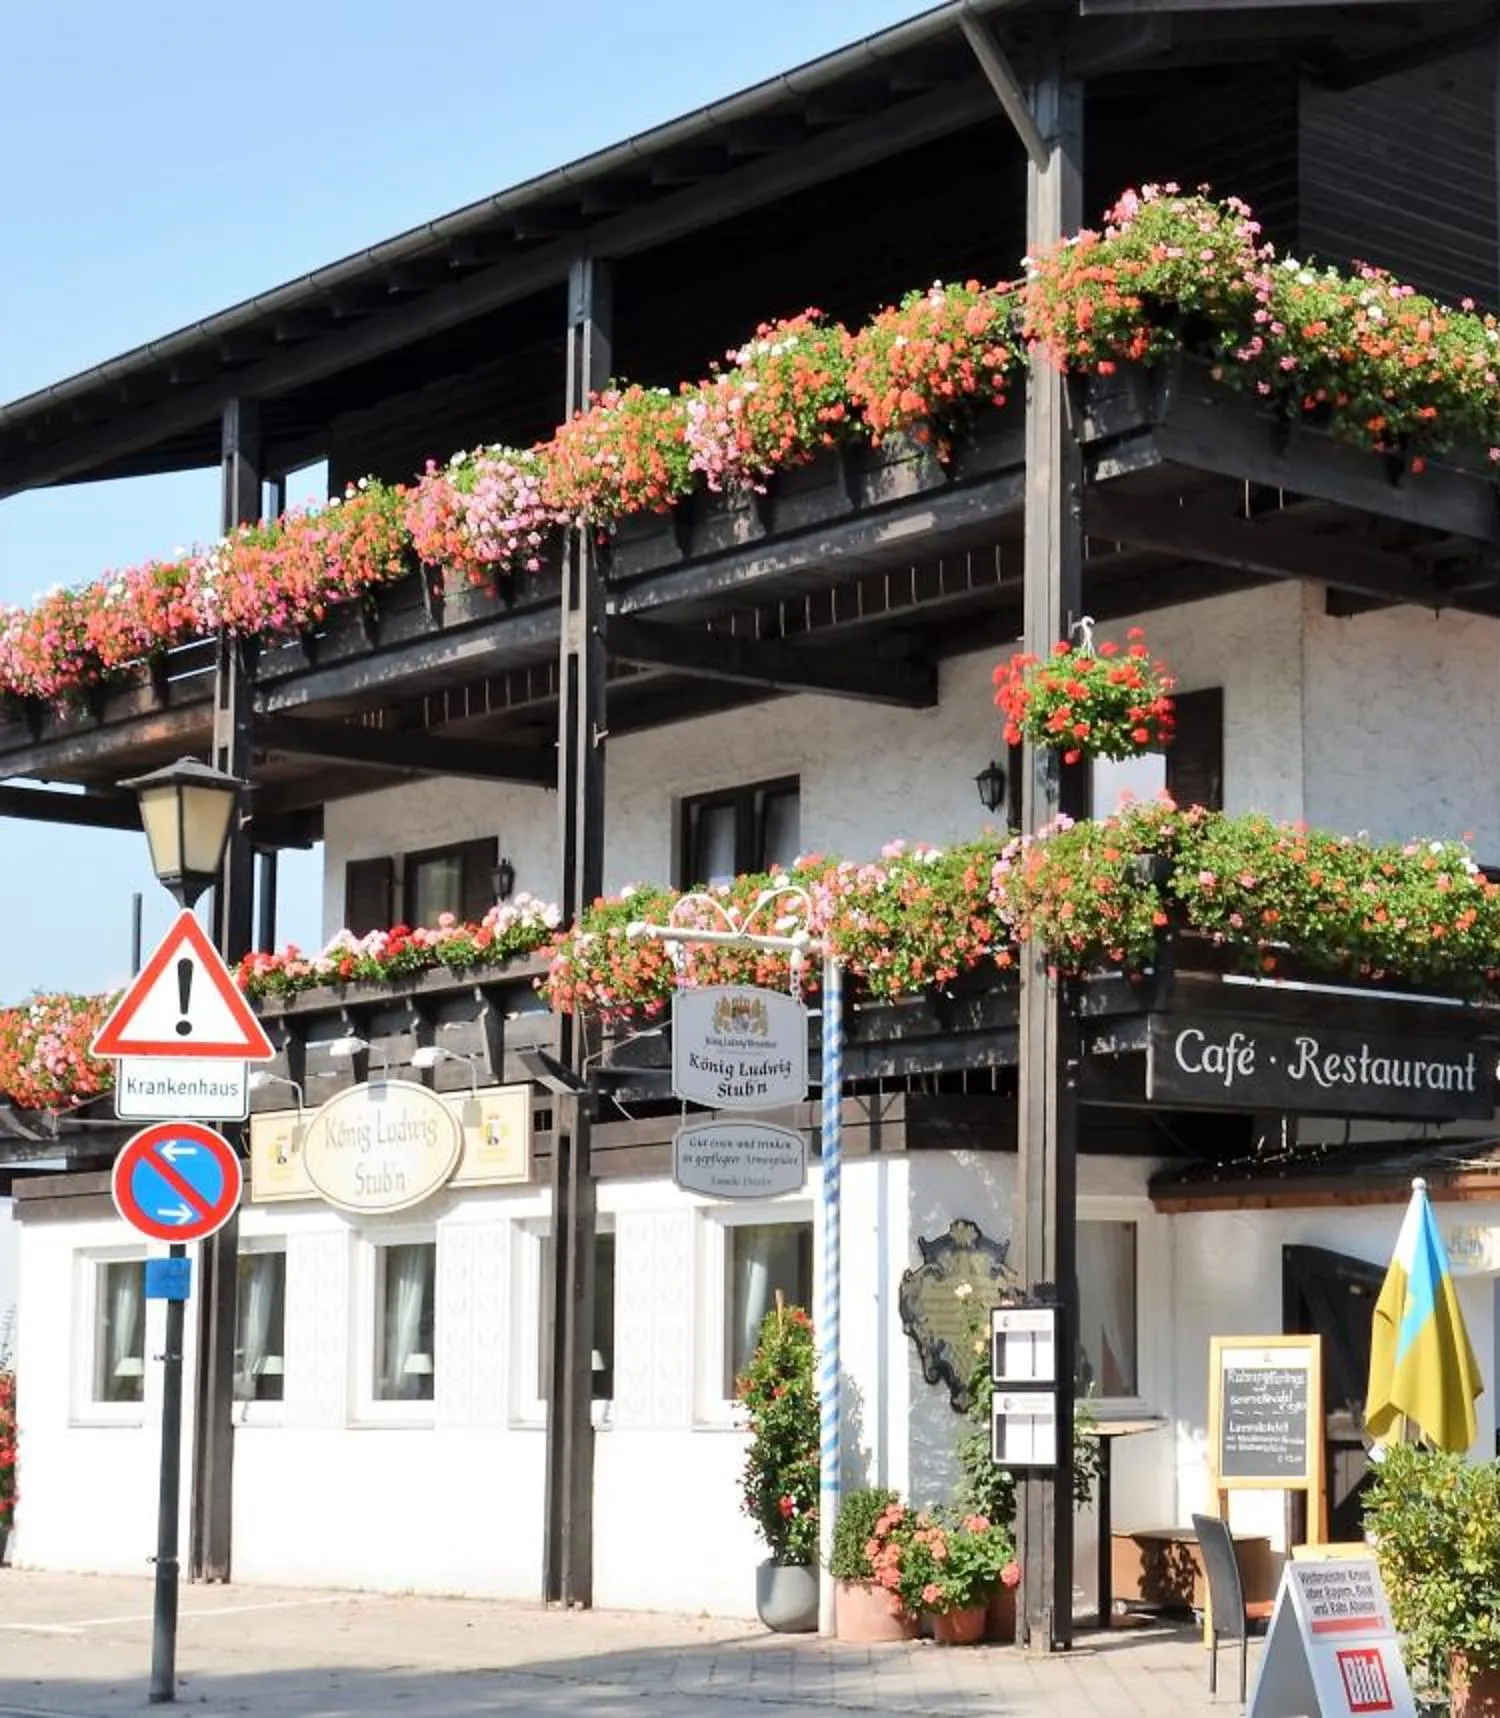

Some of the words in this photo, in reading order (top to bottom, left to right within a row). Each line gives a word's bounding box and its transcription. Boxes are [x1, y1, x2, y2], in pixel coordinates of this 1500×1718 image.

[688, 1052, 735, 1081] König
[739, 1059, 792, 1079] Ludwig
[1174, 1028, 1255, 1087] Café
[1287, 1036, 1477, 1092] Restaurant
[126, 1076, 240, 1099] Krankenhaus
[325, 1115, 372, 1153] König
[377, 1108, 438, 1148] Ludwig
